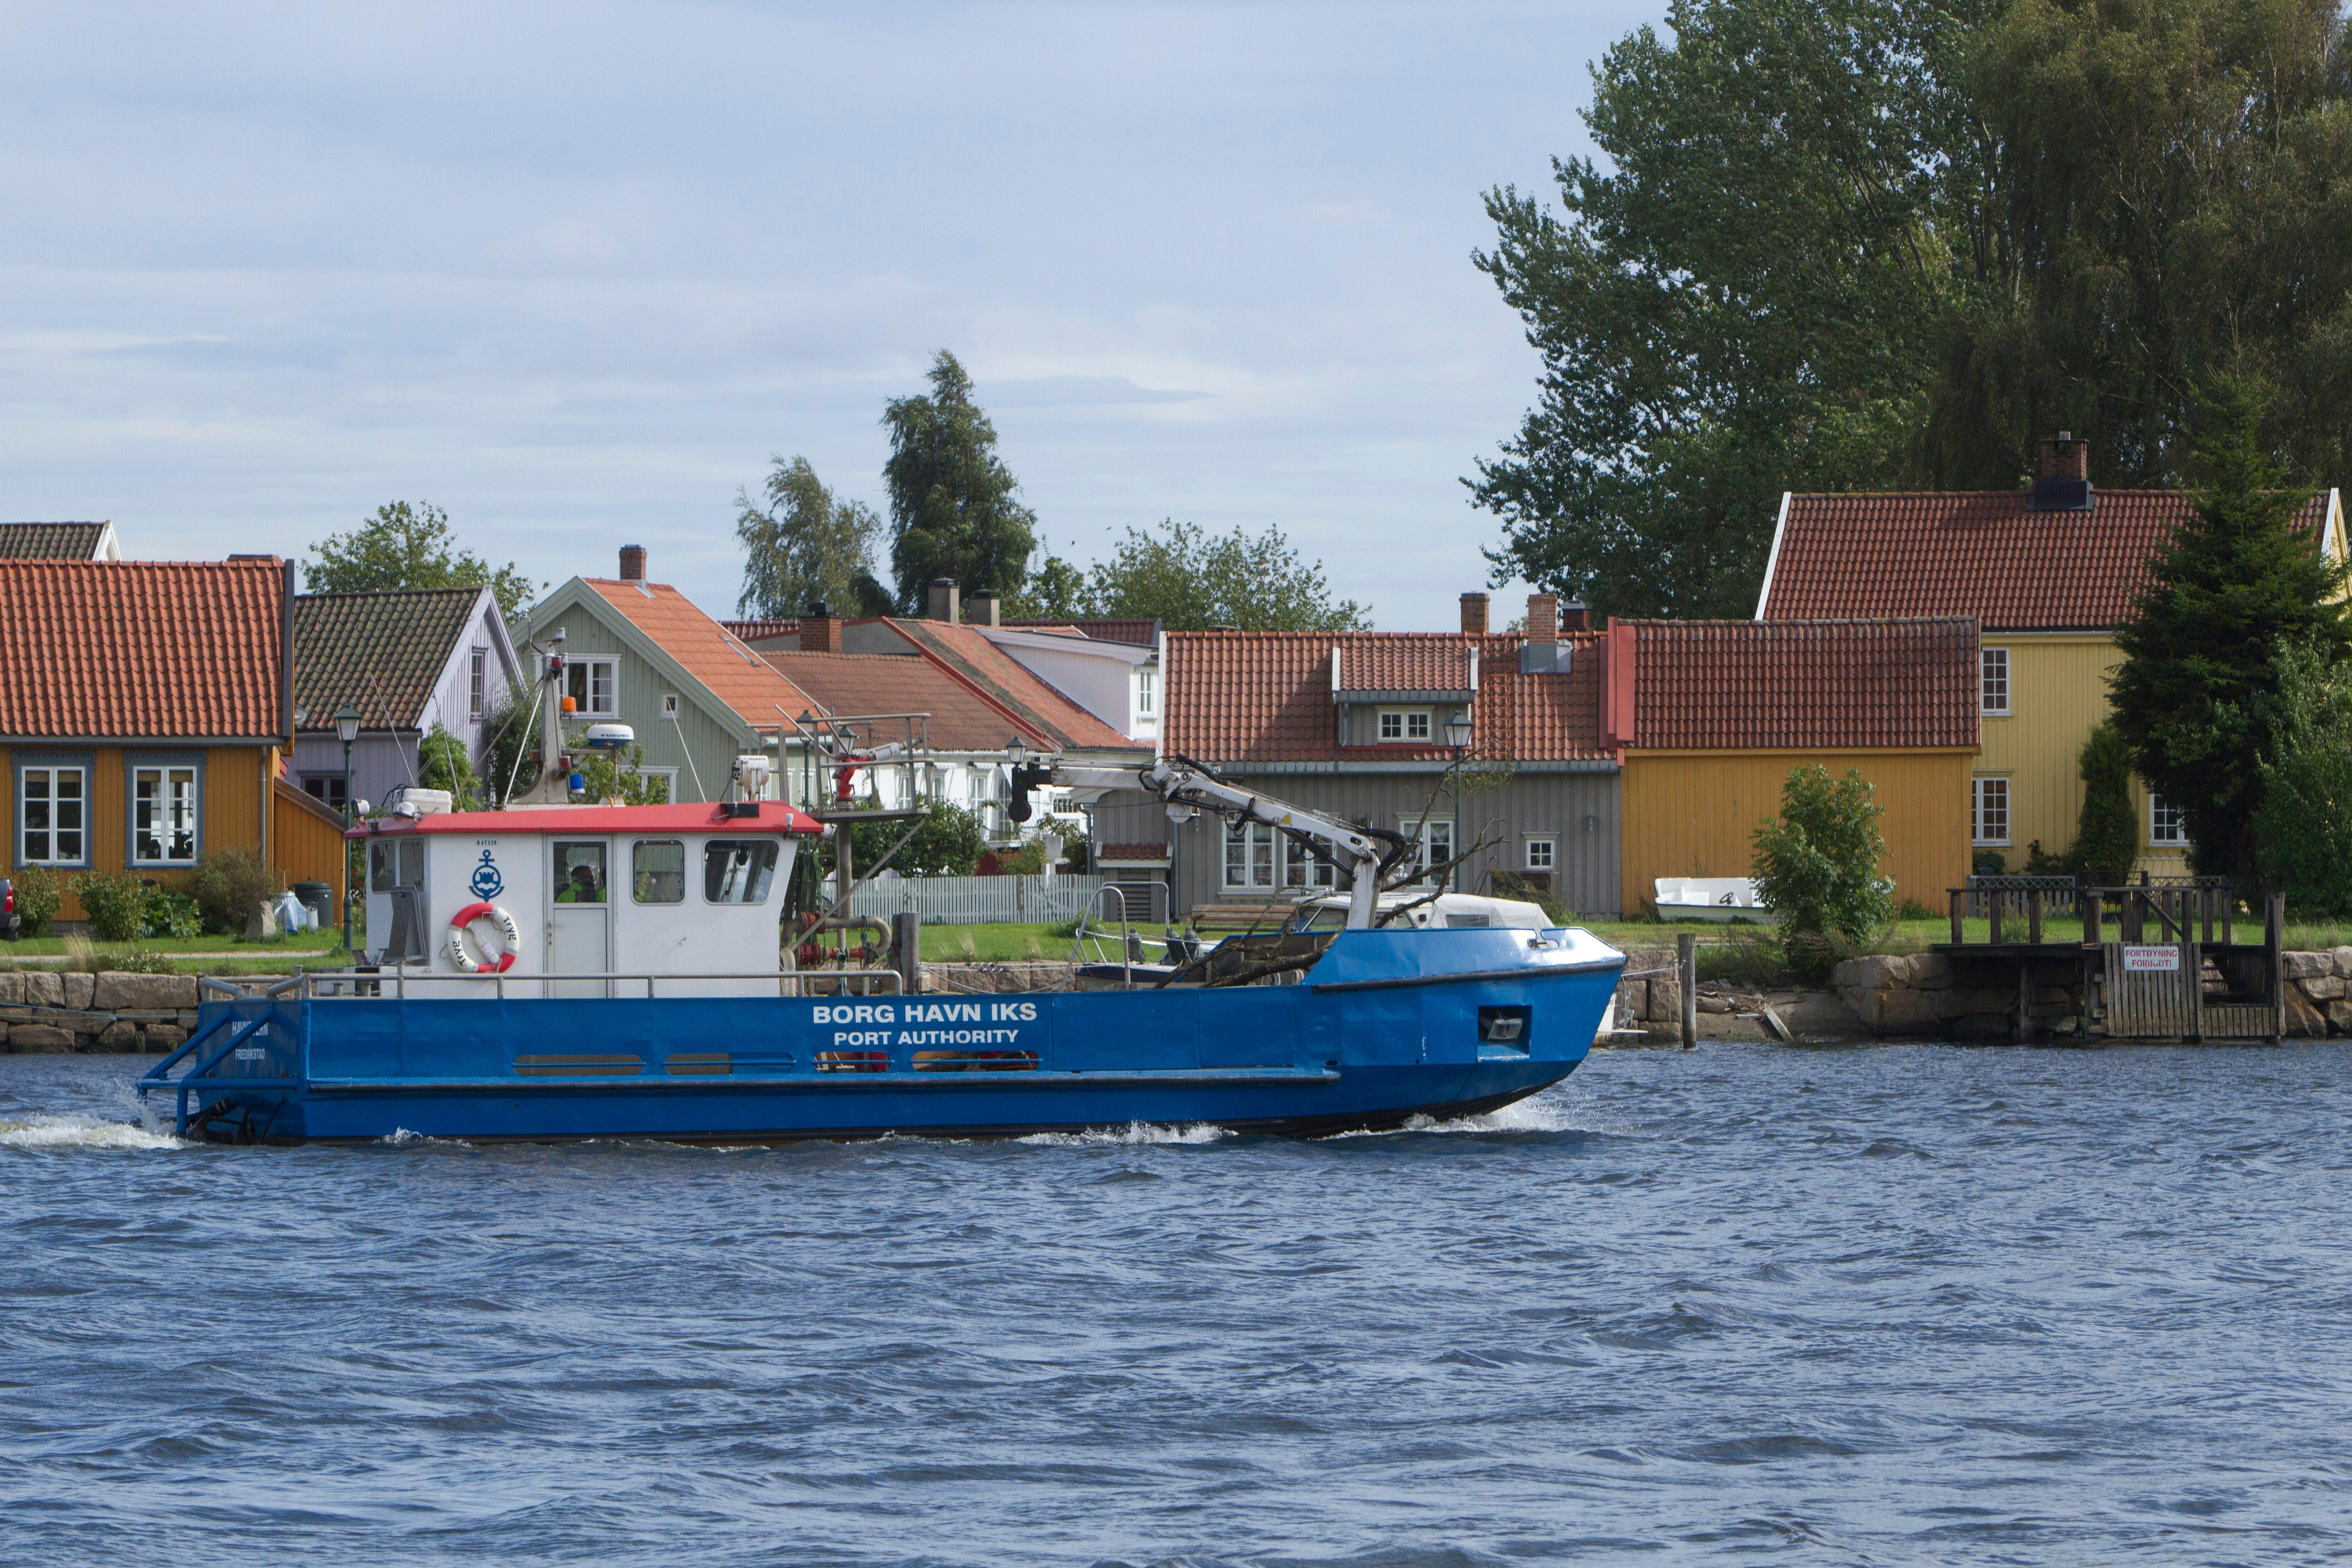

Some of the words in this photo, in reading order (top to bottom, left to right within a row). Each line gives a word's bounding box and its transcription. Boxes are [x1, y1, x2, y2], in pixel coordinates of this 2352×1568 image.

[503, 916, 516, 941] Tryg
[452, 940, 466, 966] Tryg
[2132, 959, 2172, 967] FORBUDT!
[813, 1005, 895, 1024] BORG
[905, 1004, 980, 1022] HAVN
[991, 1003, 1037, 1021] IKS
[834, 1031, 892, 1045] PORT
[898, 1029, 1019, 1044] AUTHORITY
